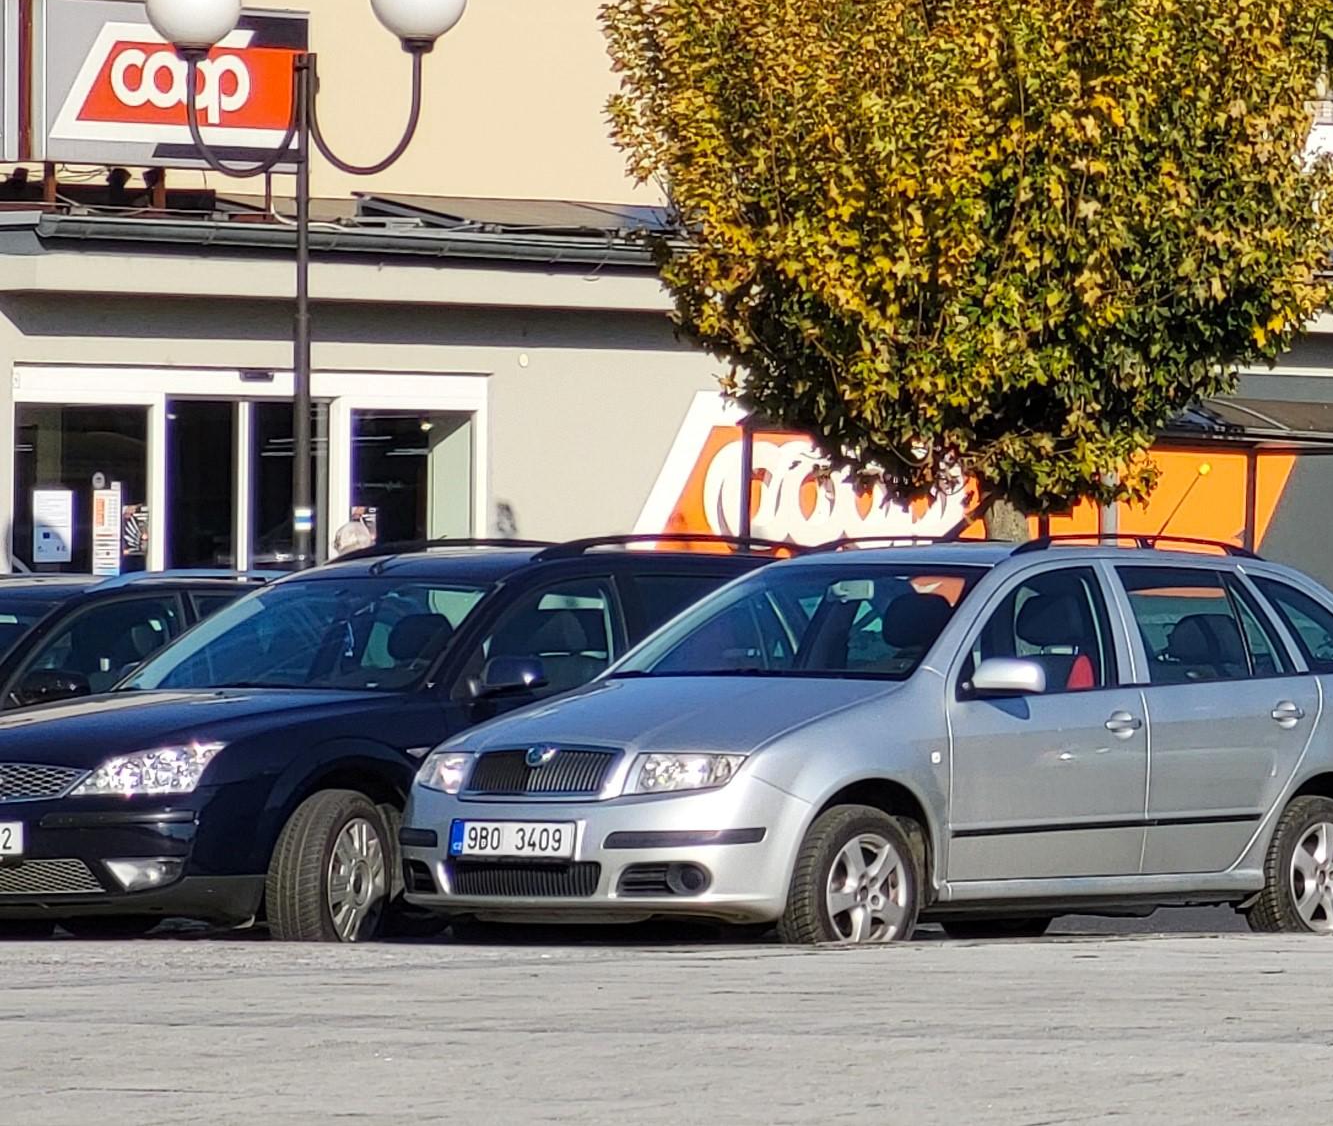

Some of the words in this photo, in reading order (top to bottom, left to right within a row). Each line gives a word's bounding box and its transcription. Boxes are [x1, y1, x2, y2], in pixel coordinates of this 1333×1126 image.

[111, 48, 250, 124] coop
[468, 826, 501, 850] 9B0
[515, 827, 562, 851] 3409
